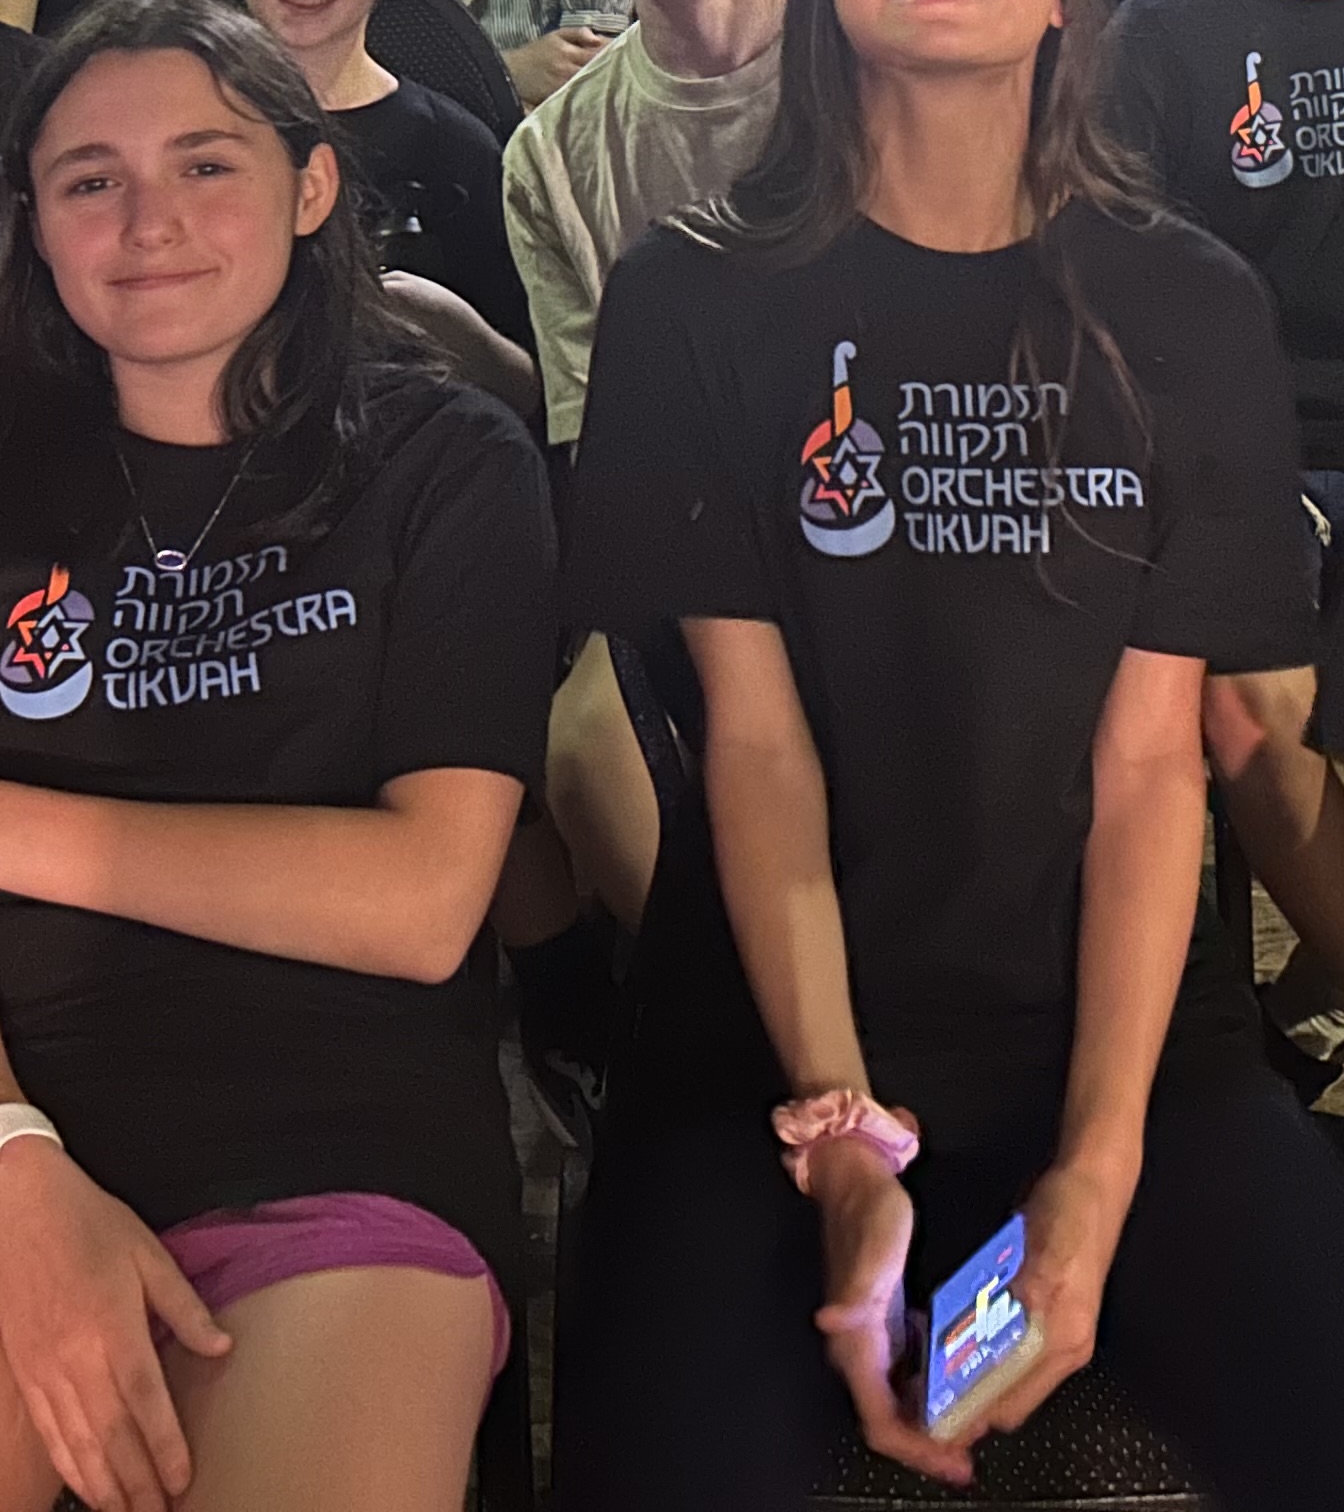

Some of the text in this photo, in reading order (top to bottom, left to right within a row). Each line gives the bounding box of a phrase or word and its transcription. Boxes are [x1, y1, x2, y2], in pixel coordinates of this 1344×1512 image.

[897, 381, 1068, 422] תזמורת
[898, 421, 1029, 465] תקווה
[901, 466, 1144, 507] ORCHESTRA
[116, 545, 287, 597] תזמורת
[106, 588, 357, 669] ORCHESTRA
[114, 588, 245, 633] תקווה
